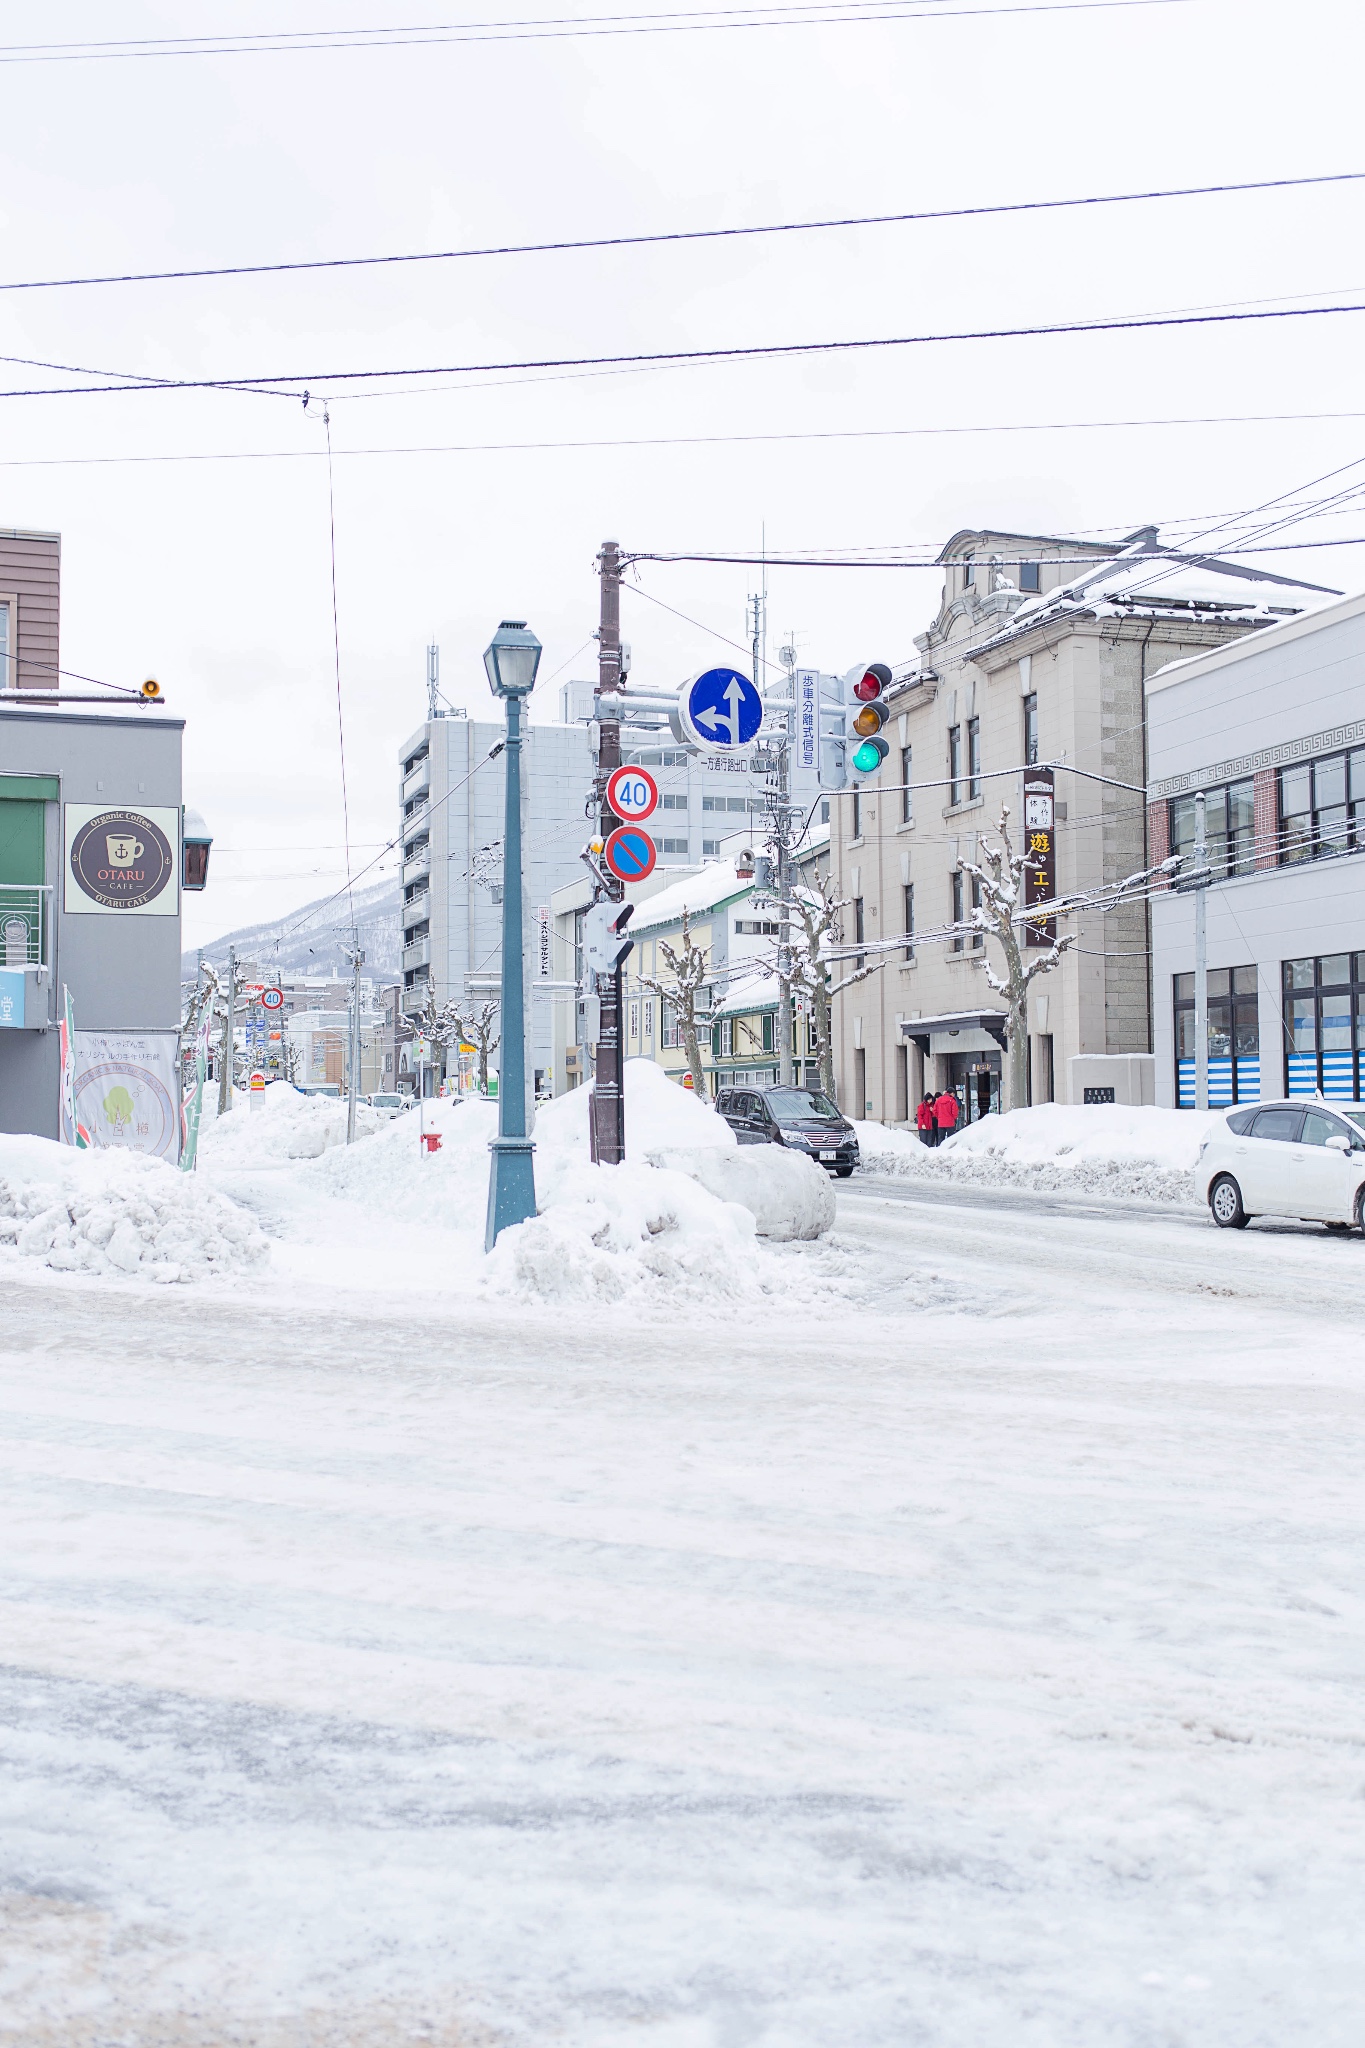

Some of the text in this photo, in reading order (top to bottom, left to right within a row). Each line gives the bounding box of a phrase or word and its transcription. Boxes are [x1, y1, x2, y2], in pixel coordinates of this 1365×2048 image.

[802, 675, 814, 765] 歩車分離式信号
[620, 781, 647, 806] 40
[90, 812, 152, 829] Organic Coffee
[97, 869, 145, 881] OTARU
[109, 882, 134, 890] CAFE
[95, 894, 150, 908] OTARU CAFE
[266, 993, 279, 1004] 40
